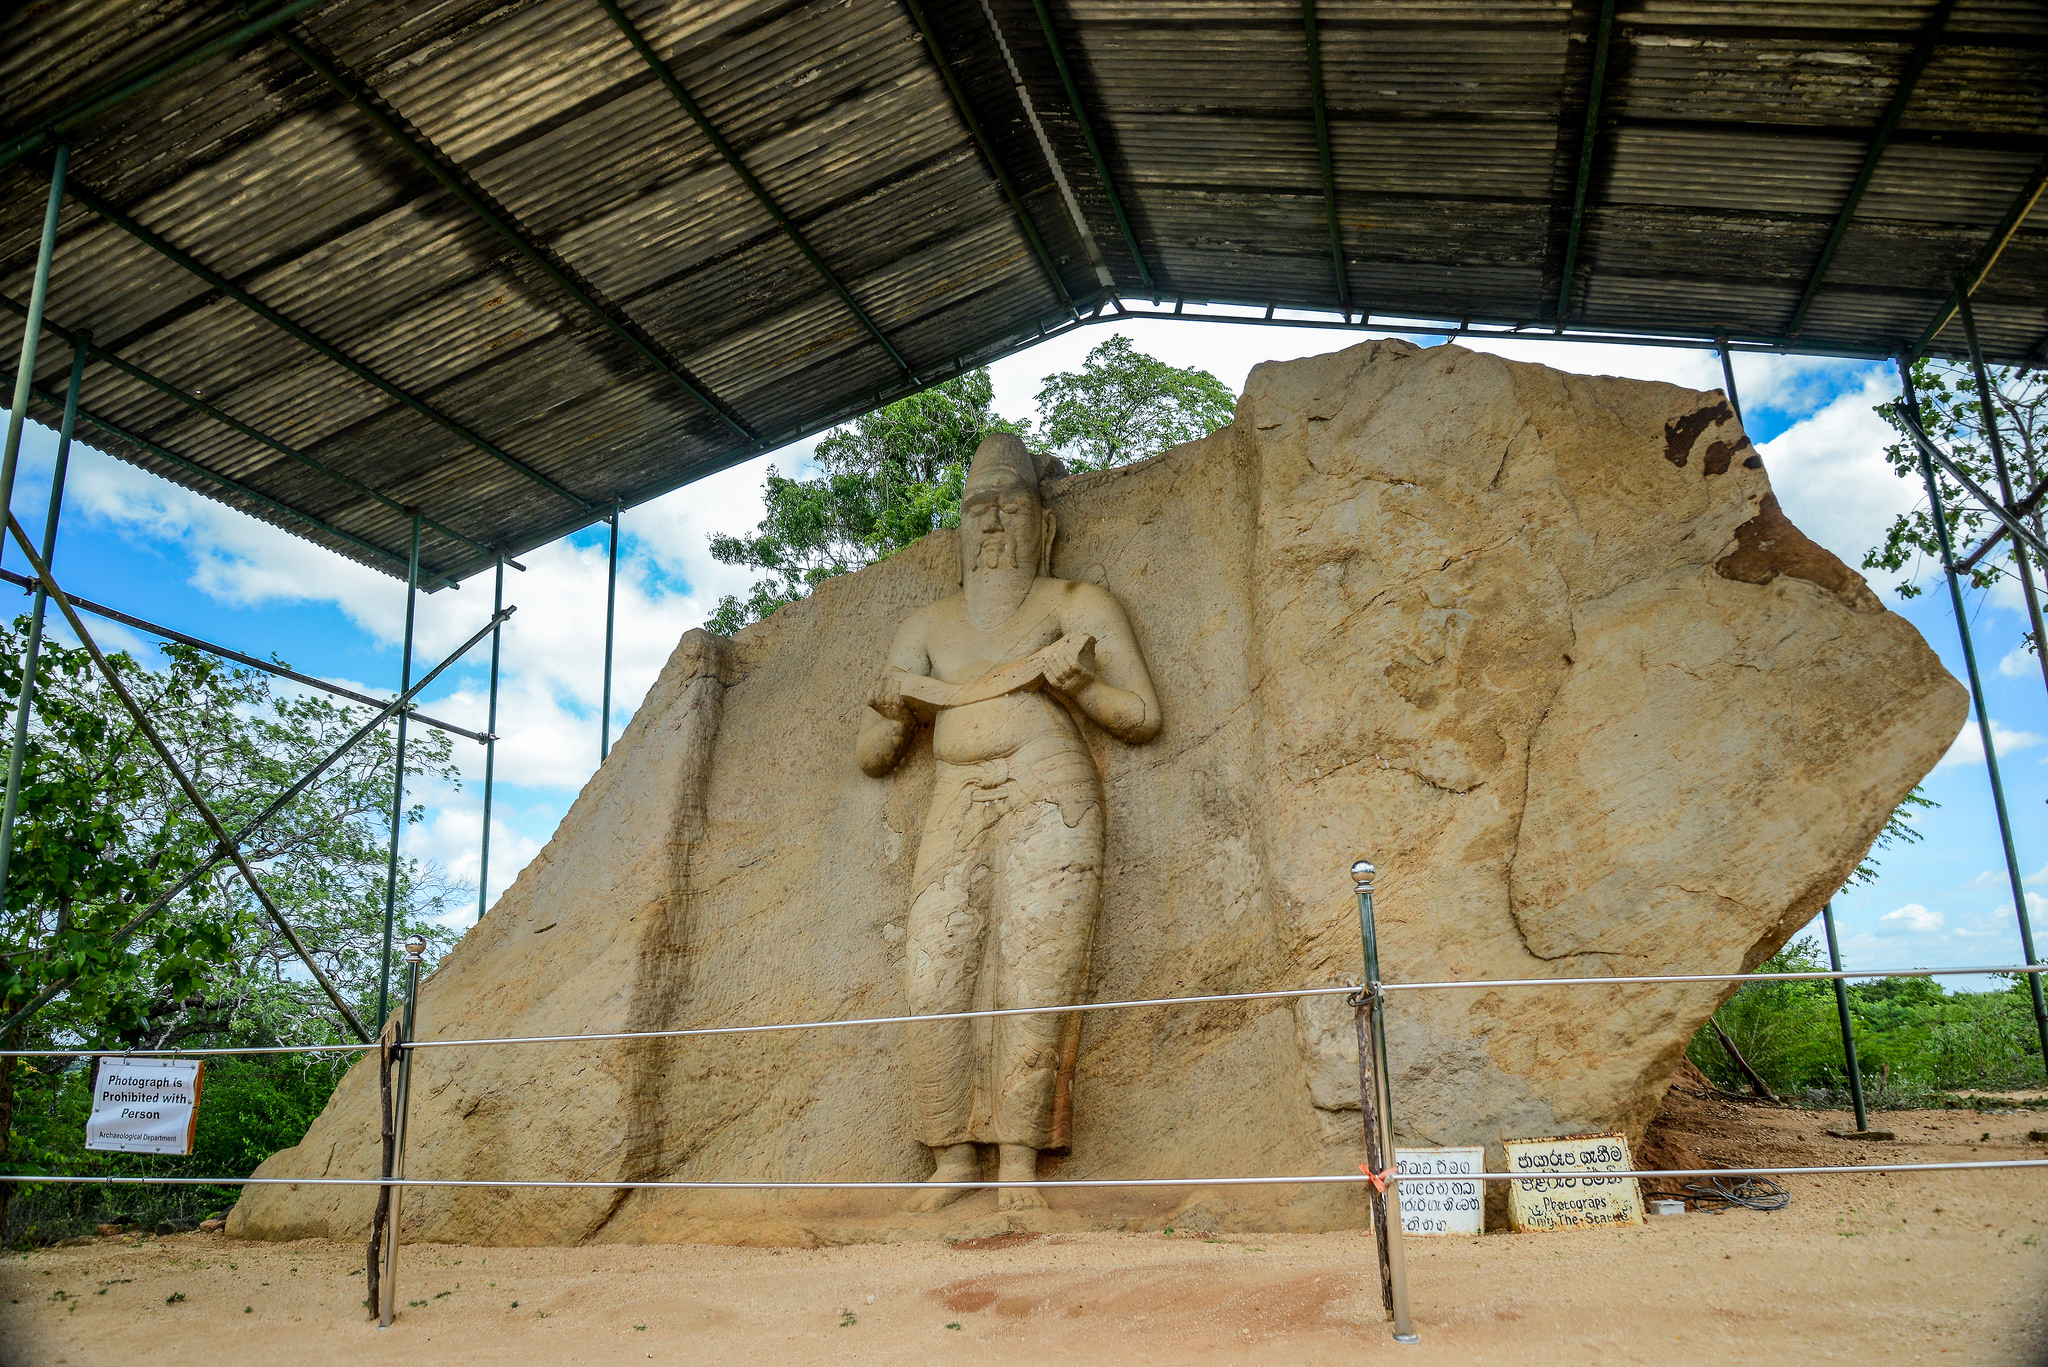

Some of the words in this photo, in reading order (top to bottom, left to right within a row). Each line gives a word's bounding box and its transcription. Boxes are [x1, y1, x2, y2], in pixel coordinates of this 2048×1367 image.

[108, 1075, 169, 1089] Photograph
[173, 1077, 183, 1088] is
[102, 1091, 159, 1103] Prohibited
[163, 1093, 187, 1104] with
[121, 1108, 160, 1119] Person
[99, 1131, 142, 1141] Archaeological
[143, 1133, 177, 1142] Department
